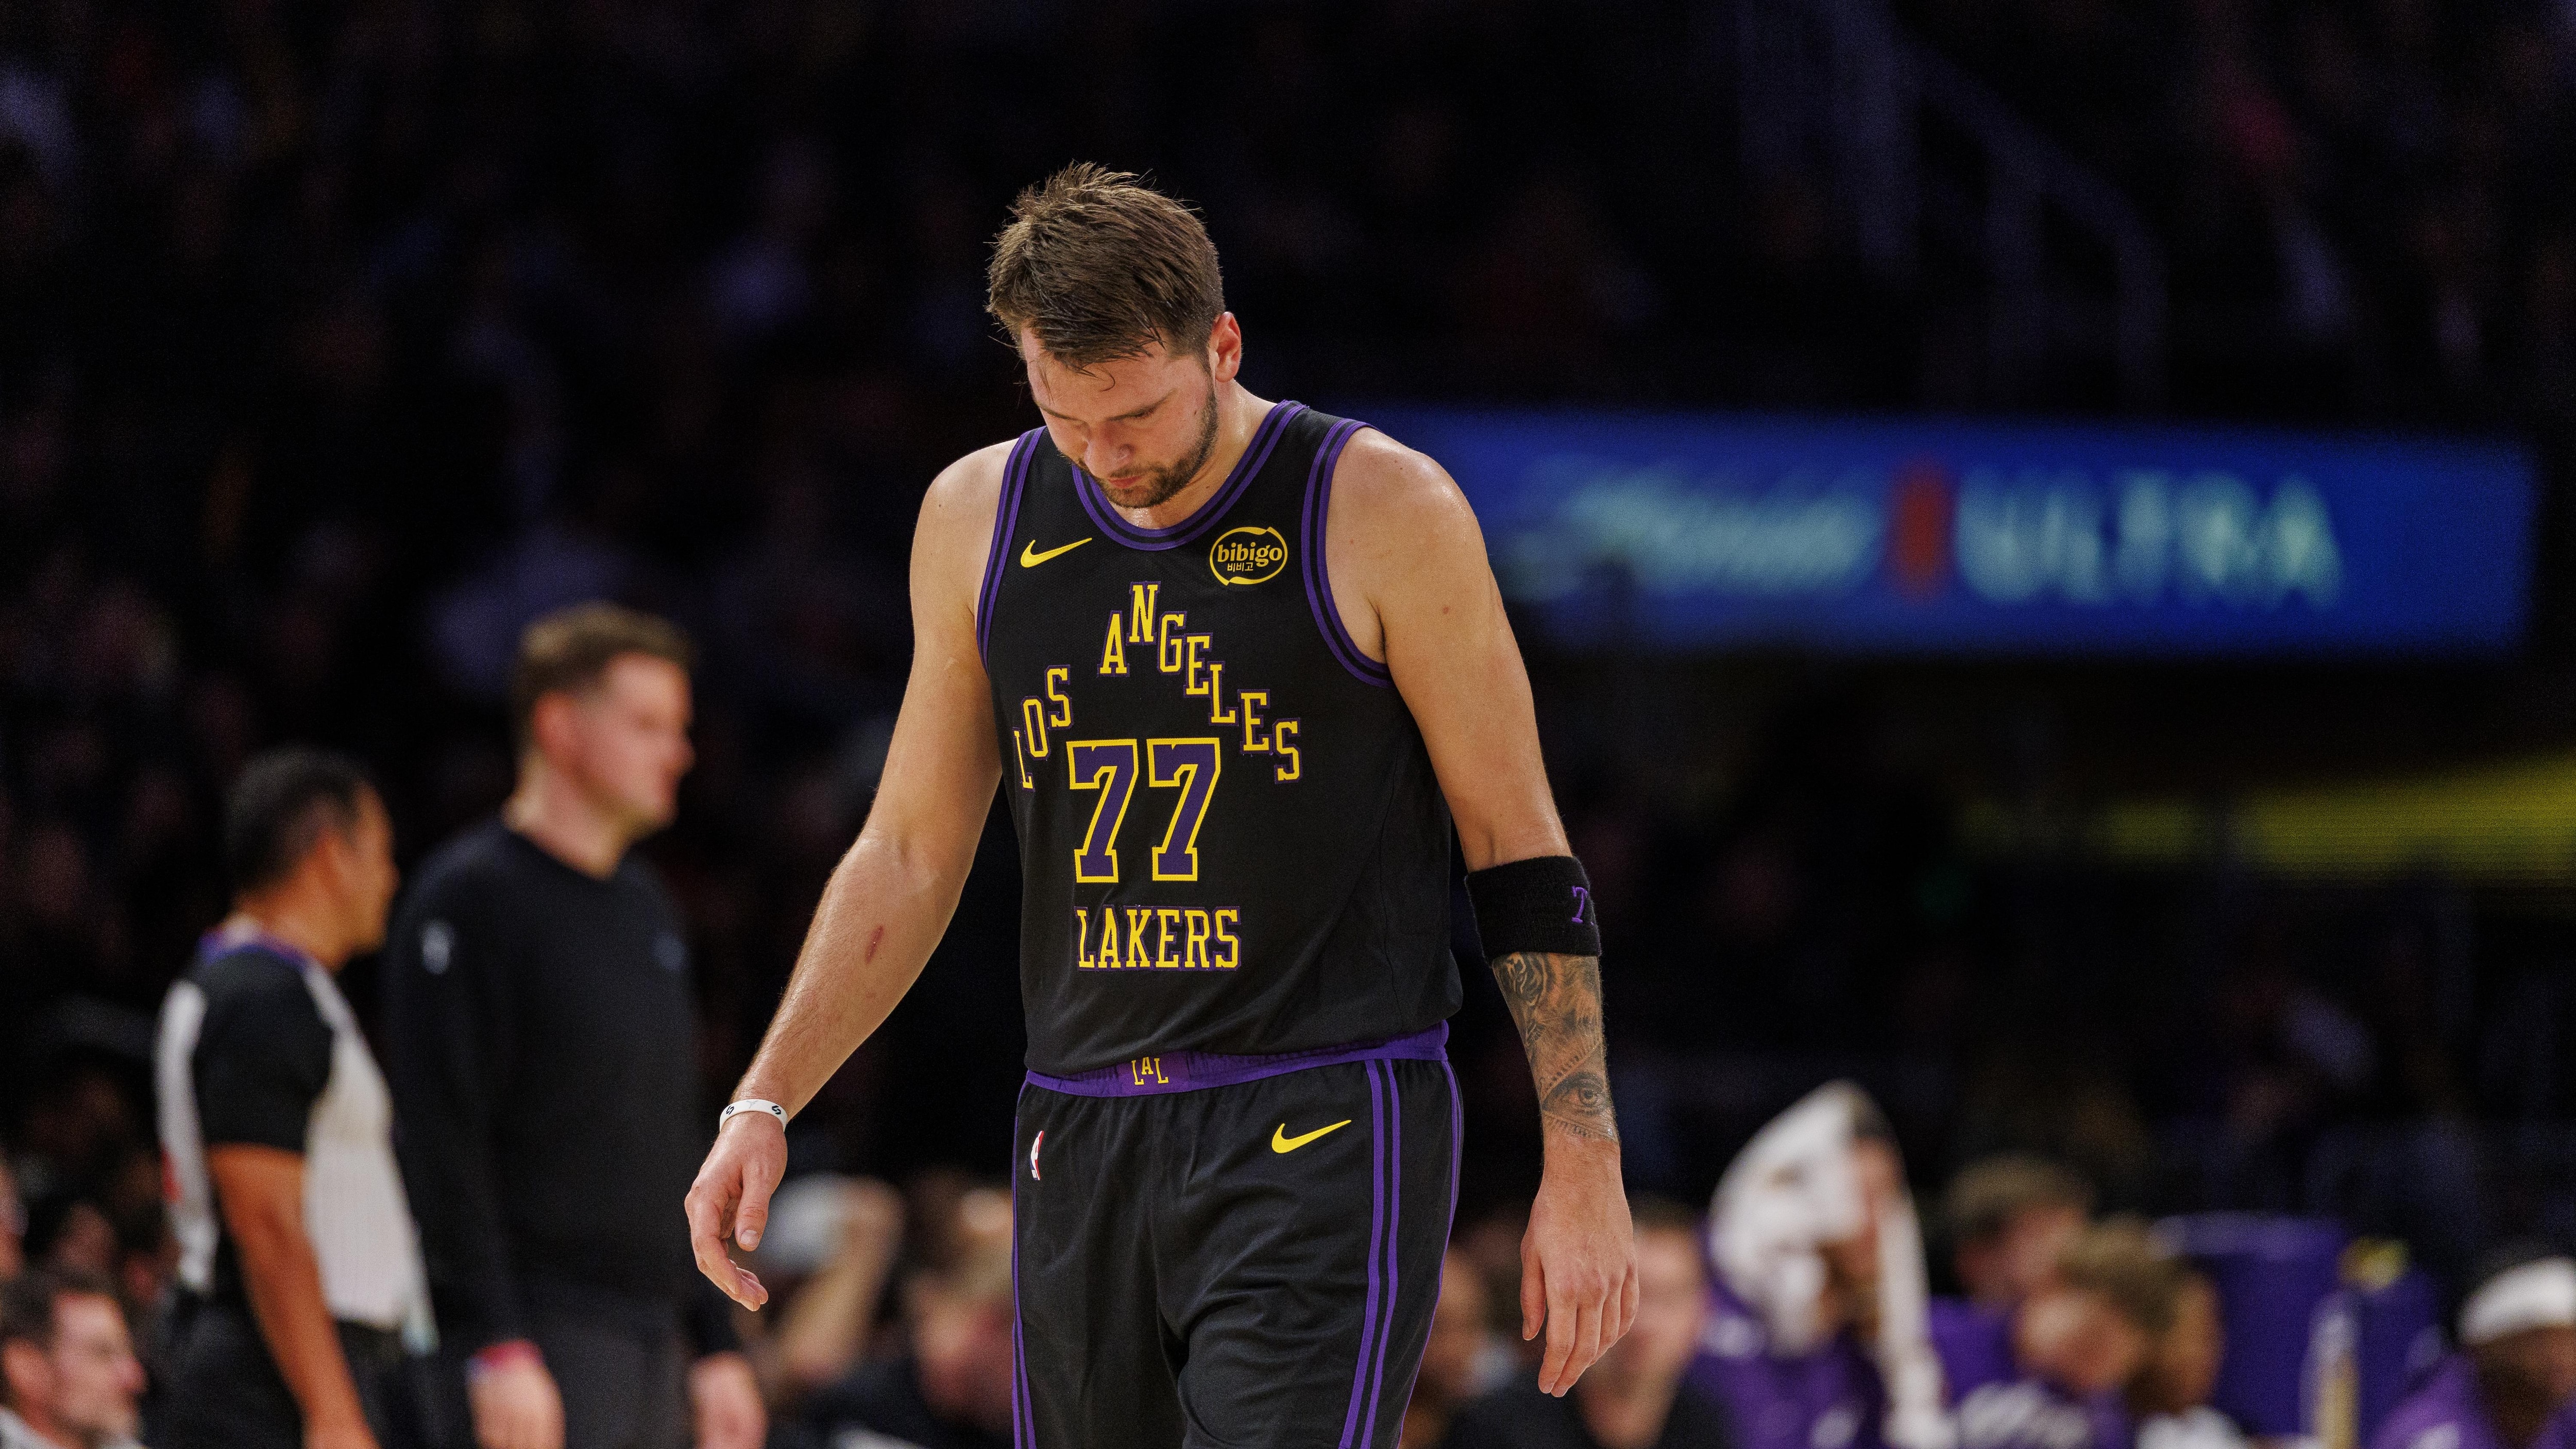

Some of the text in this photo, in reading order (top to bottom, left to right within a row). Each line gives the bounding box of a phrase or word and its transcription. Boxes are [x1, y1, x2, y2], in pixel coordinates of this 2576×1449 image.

[1217, 542, 1282, 567] bibigo
[1227, 562, 1253, 572] 비비고
[1013, 582, 1301, 792] LOS ANGELES
[1066, 738, 1221, 882] 77
[1572, 885, 1595, 926] 7
[1074, 906, 1241, 971] LAKERS
[1131, 1057, 1169, 1085] LAL
